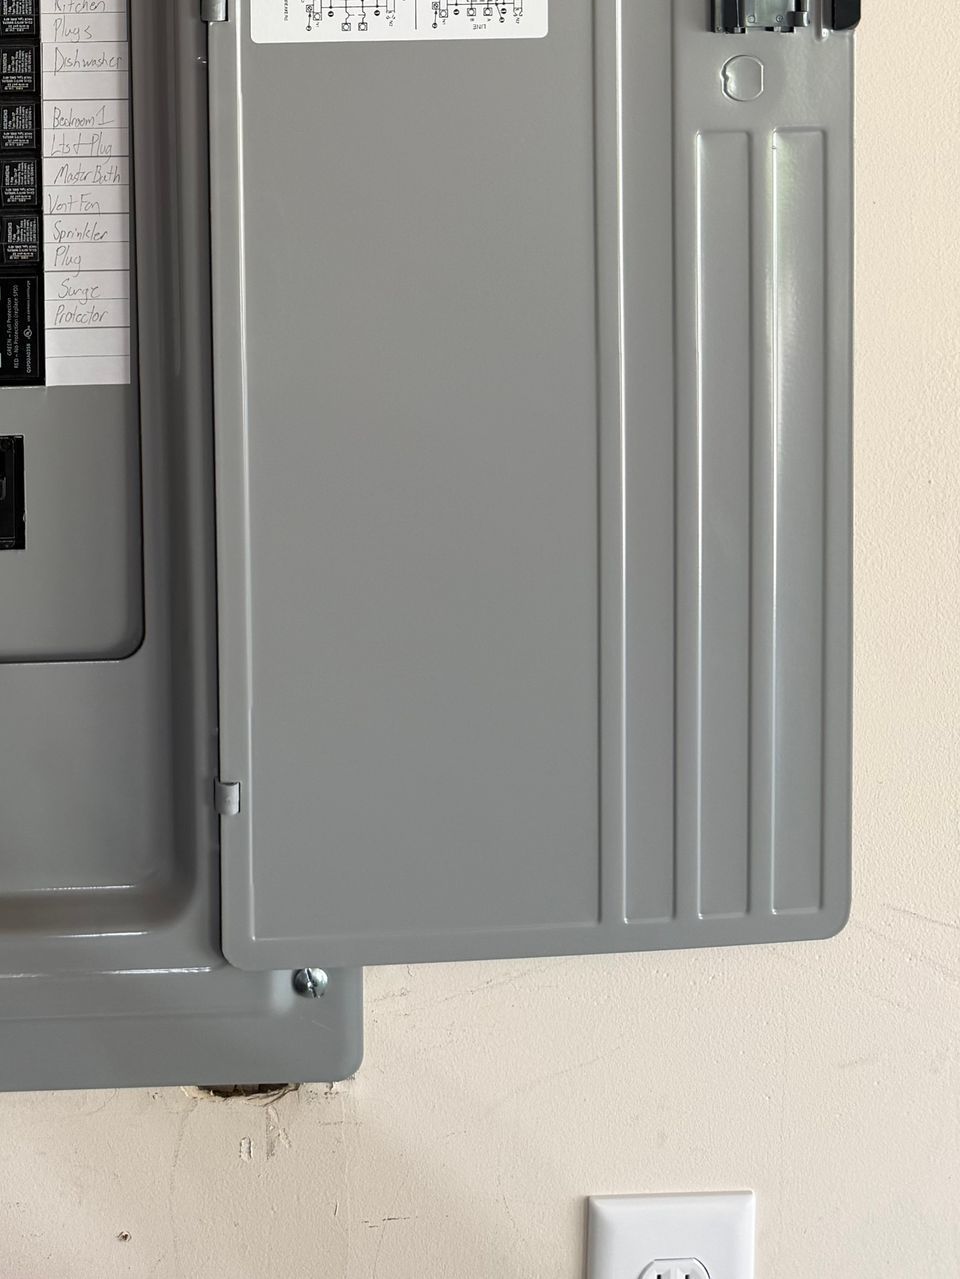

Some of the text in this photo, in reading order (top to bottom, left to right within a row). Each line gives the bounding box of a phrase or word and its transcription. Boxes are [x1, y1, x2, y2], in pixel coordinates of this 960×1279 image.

[53, 46, 123, 76] Dishwasher
[52, 106, 95, 130] Bedroom
[90, 131, 113, 164] Plug
[53, 162, 92, 185] Master
[93, 164, 121, 184] Bath
[79, 192, 101, 214] Fan
[53, 220, 108, 242] Sprinkler
[54, 245, 82, 277] Plug
[58, 278, 101, 305] Surge
[54, 304, 108, 326] Protector
